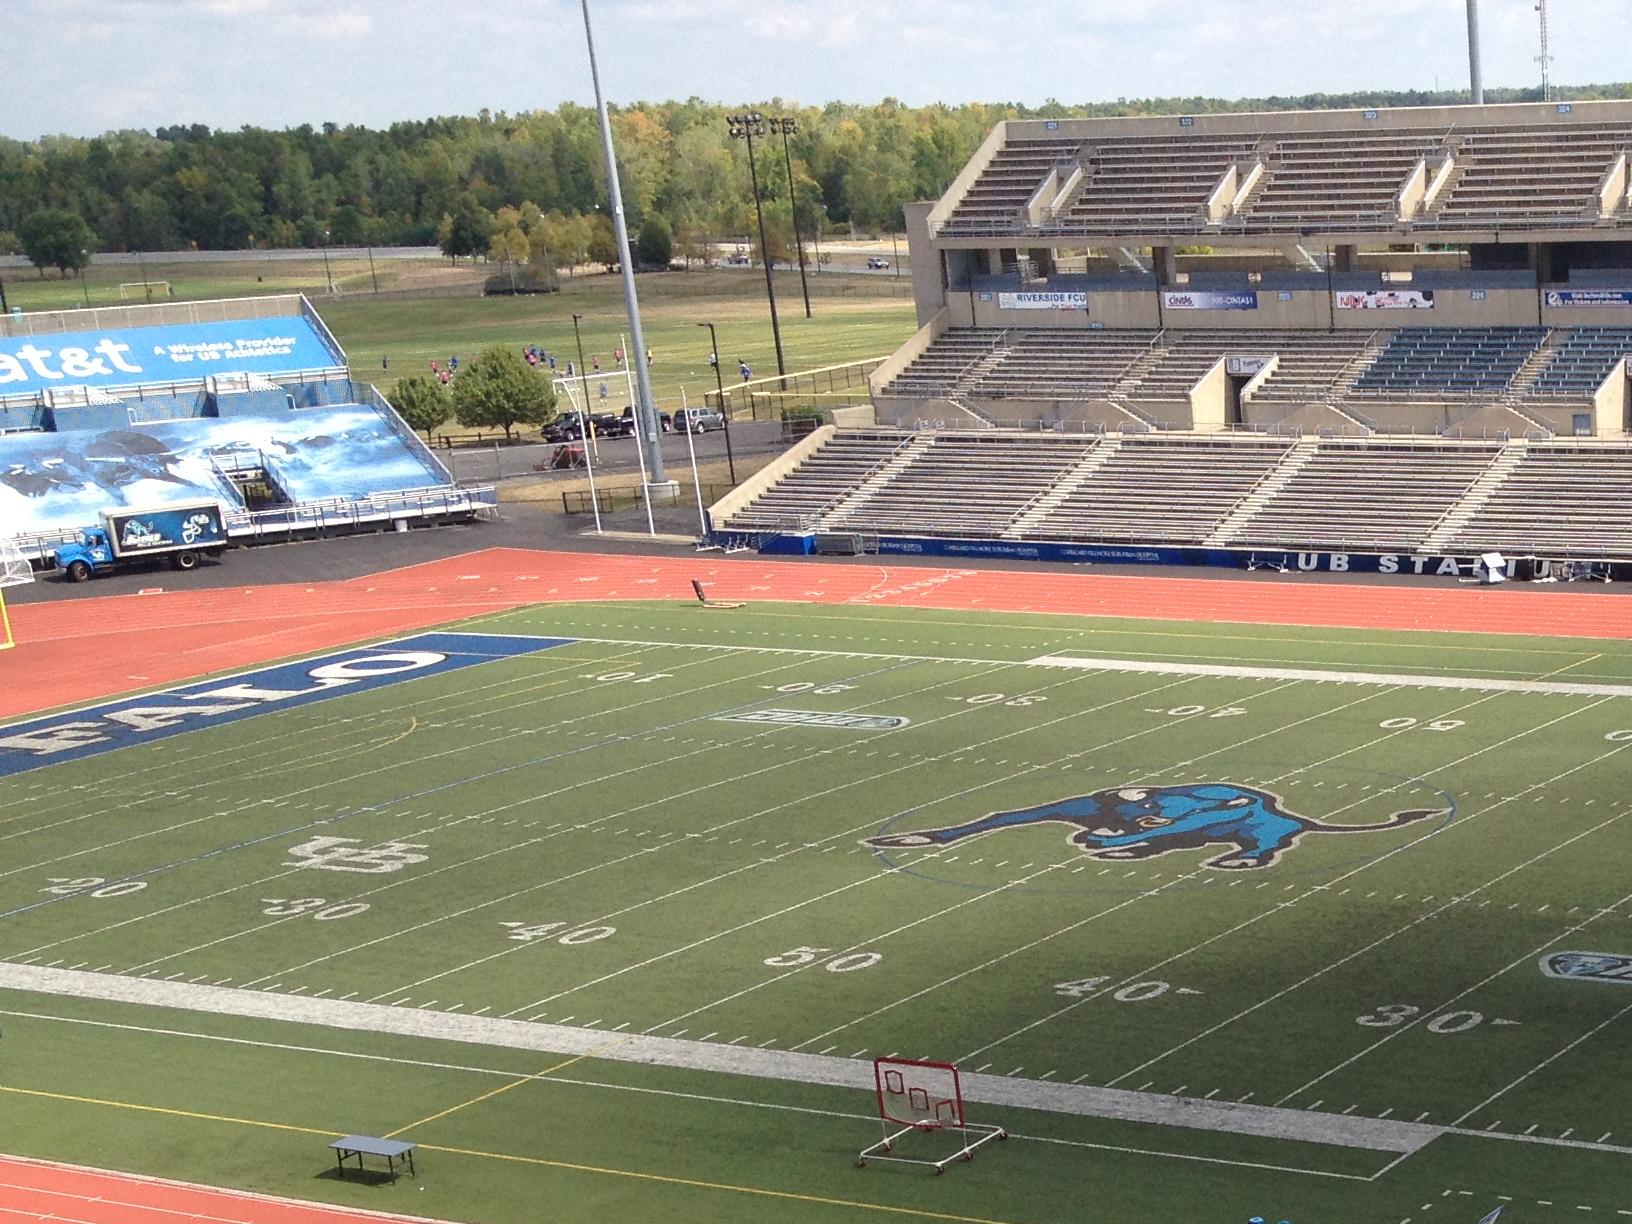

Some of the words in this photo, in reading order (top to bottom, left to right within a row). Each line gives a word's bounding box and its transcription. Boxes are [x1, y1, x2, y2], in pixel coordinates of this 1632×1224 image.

[1017, 294, 1065, 302] RIVERSIDE
[1068, 294, 1086, 302] FCU
[0, 339, 143, 383] at&t
[1298, 553, 1350, 571] UB
[1379, 717, 1466, 732] 50
[281, 836, 430, 874] UB
[262, 898, 371, 920] 30
[507, 921, 617, 945] 40
[763, 946, 883, 972] 50
[1053, 975, 1170, 1002] 40
[1354, 1003, 1484, 1034] 30
